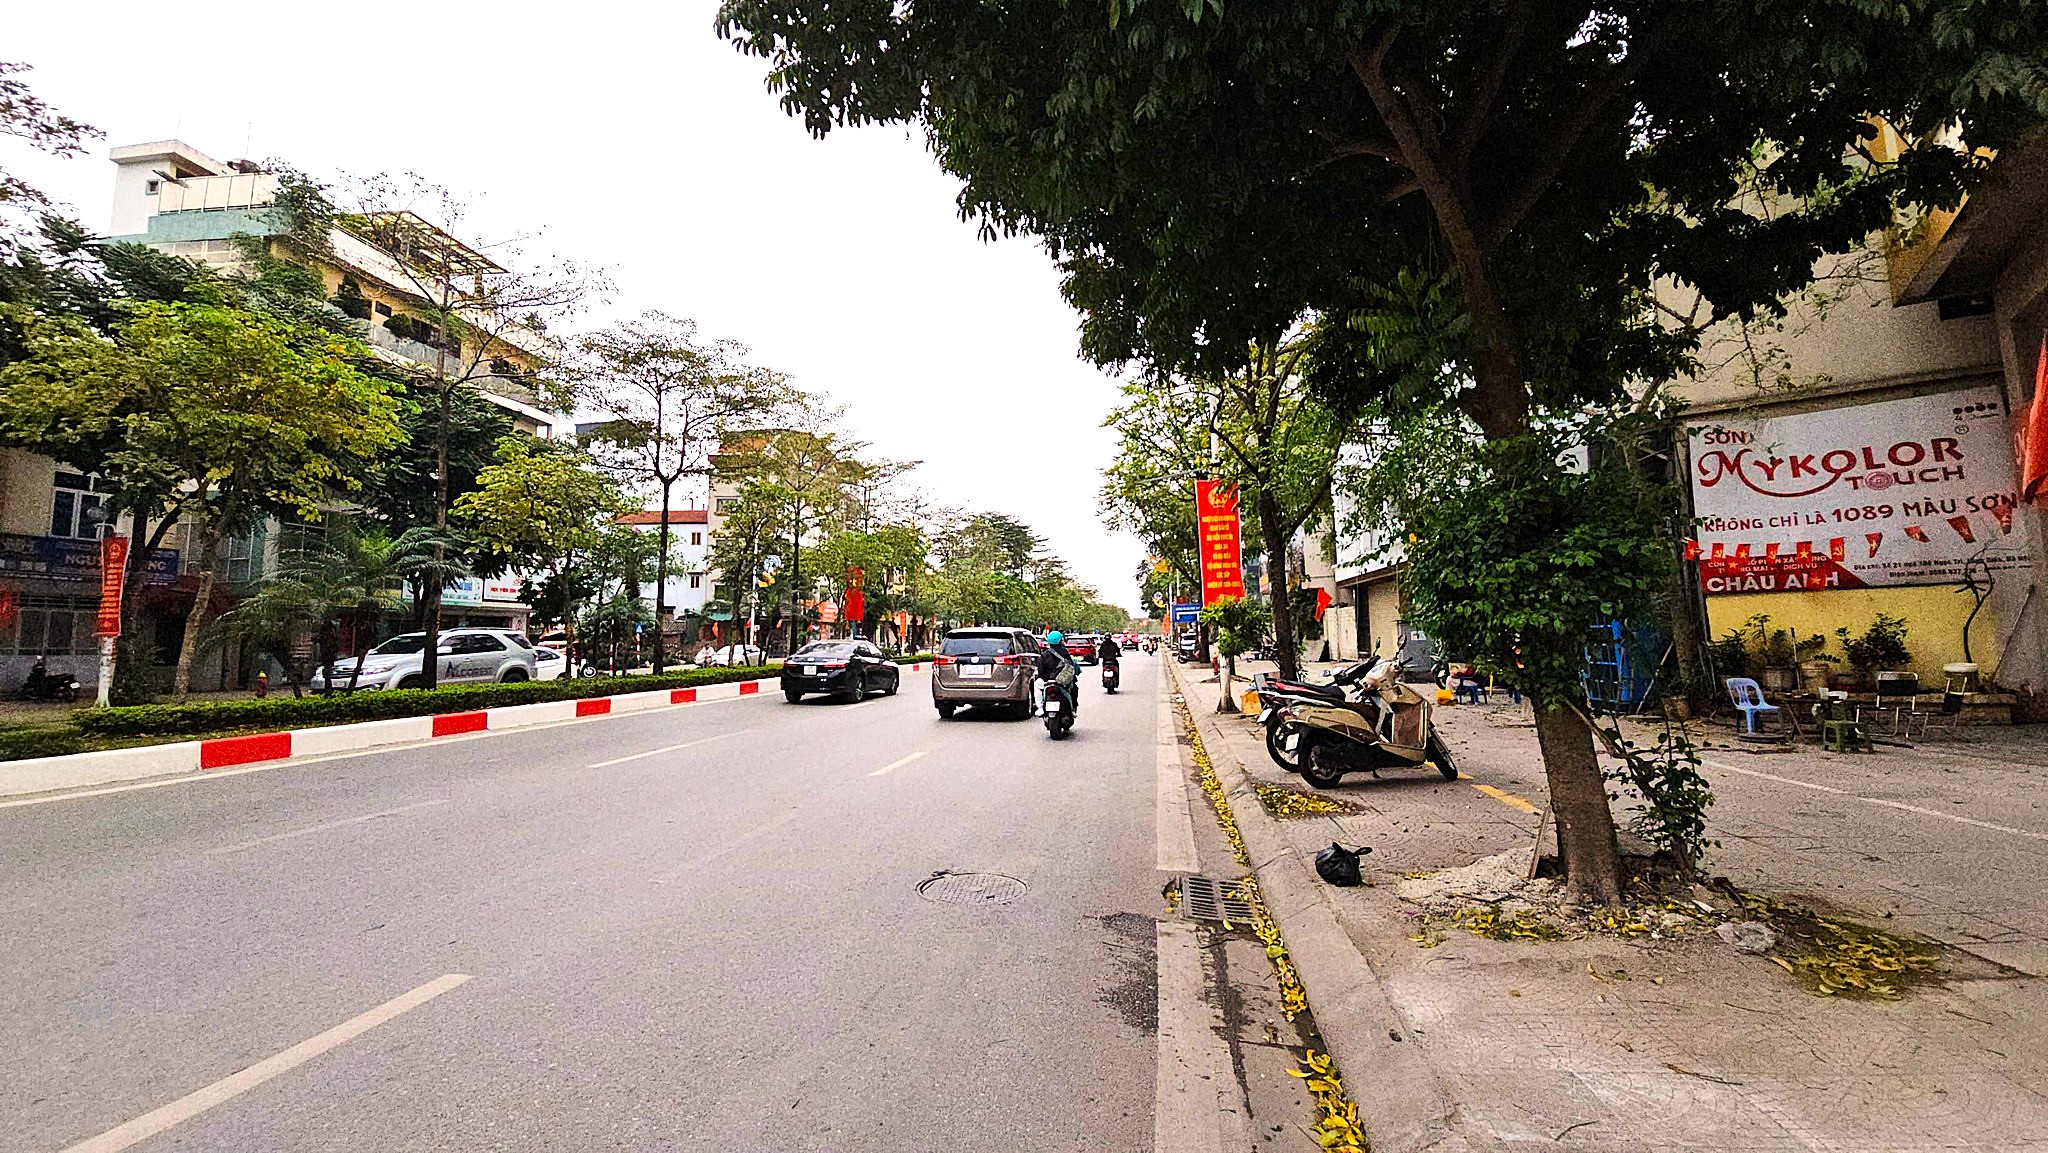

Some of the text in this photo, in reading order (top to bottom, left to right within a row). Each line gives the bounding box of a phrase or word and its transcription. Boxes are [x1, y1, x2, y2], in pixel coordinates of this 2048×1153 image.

[1698, 438, 1965, 498] MYKOLOR
[1845, 465, 1965, 491] TOUCH
[1704, 517, 1763, 533] KHÔNG
[1805, 511, 1827, 526] LÀ
[1832, 504, 1894, 523] 1089
[1903, 497, 1957, 517] MÀU
[1965, 492, 2018, 513] SƠN
[1707, 571, 1840, 592] CHÂU AH
